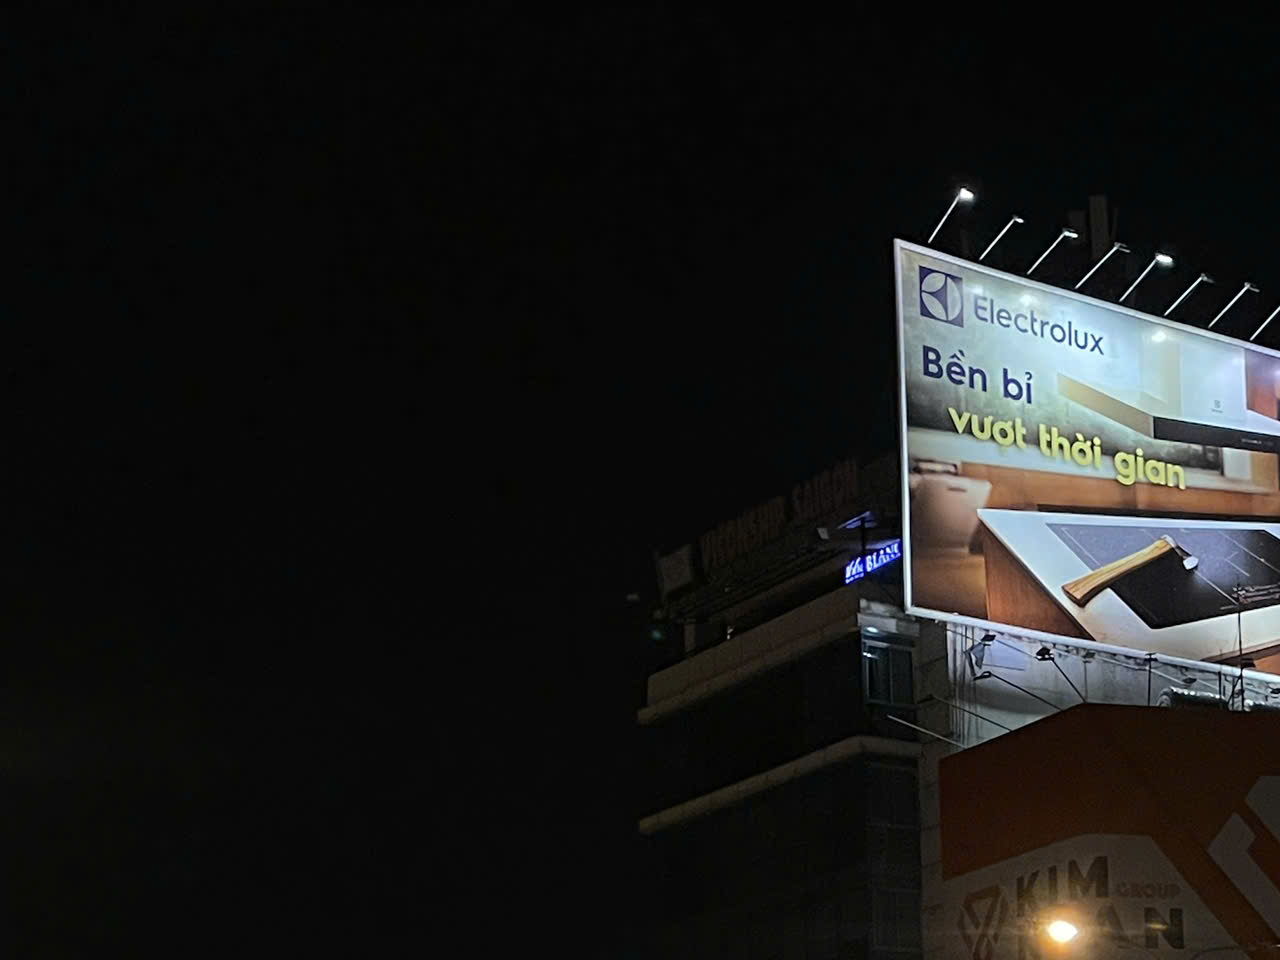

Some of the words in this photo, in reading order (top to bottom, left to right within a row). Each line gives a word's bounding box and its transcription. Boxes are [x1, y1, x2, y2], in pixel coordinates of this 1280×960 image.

[974, 296, 1105, 356] Electrolux
[922, 345, 988, 393] Bền
[1002, 367, 1033, 404] bỉ
[1038, 423, 1102, 469] thời
[1114, 447, 1187, 490] gian
[1016, 855, 1109, 918] KIM
[1117, 882, 1182, 899] GROUP
